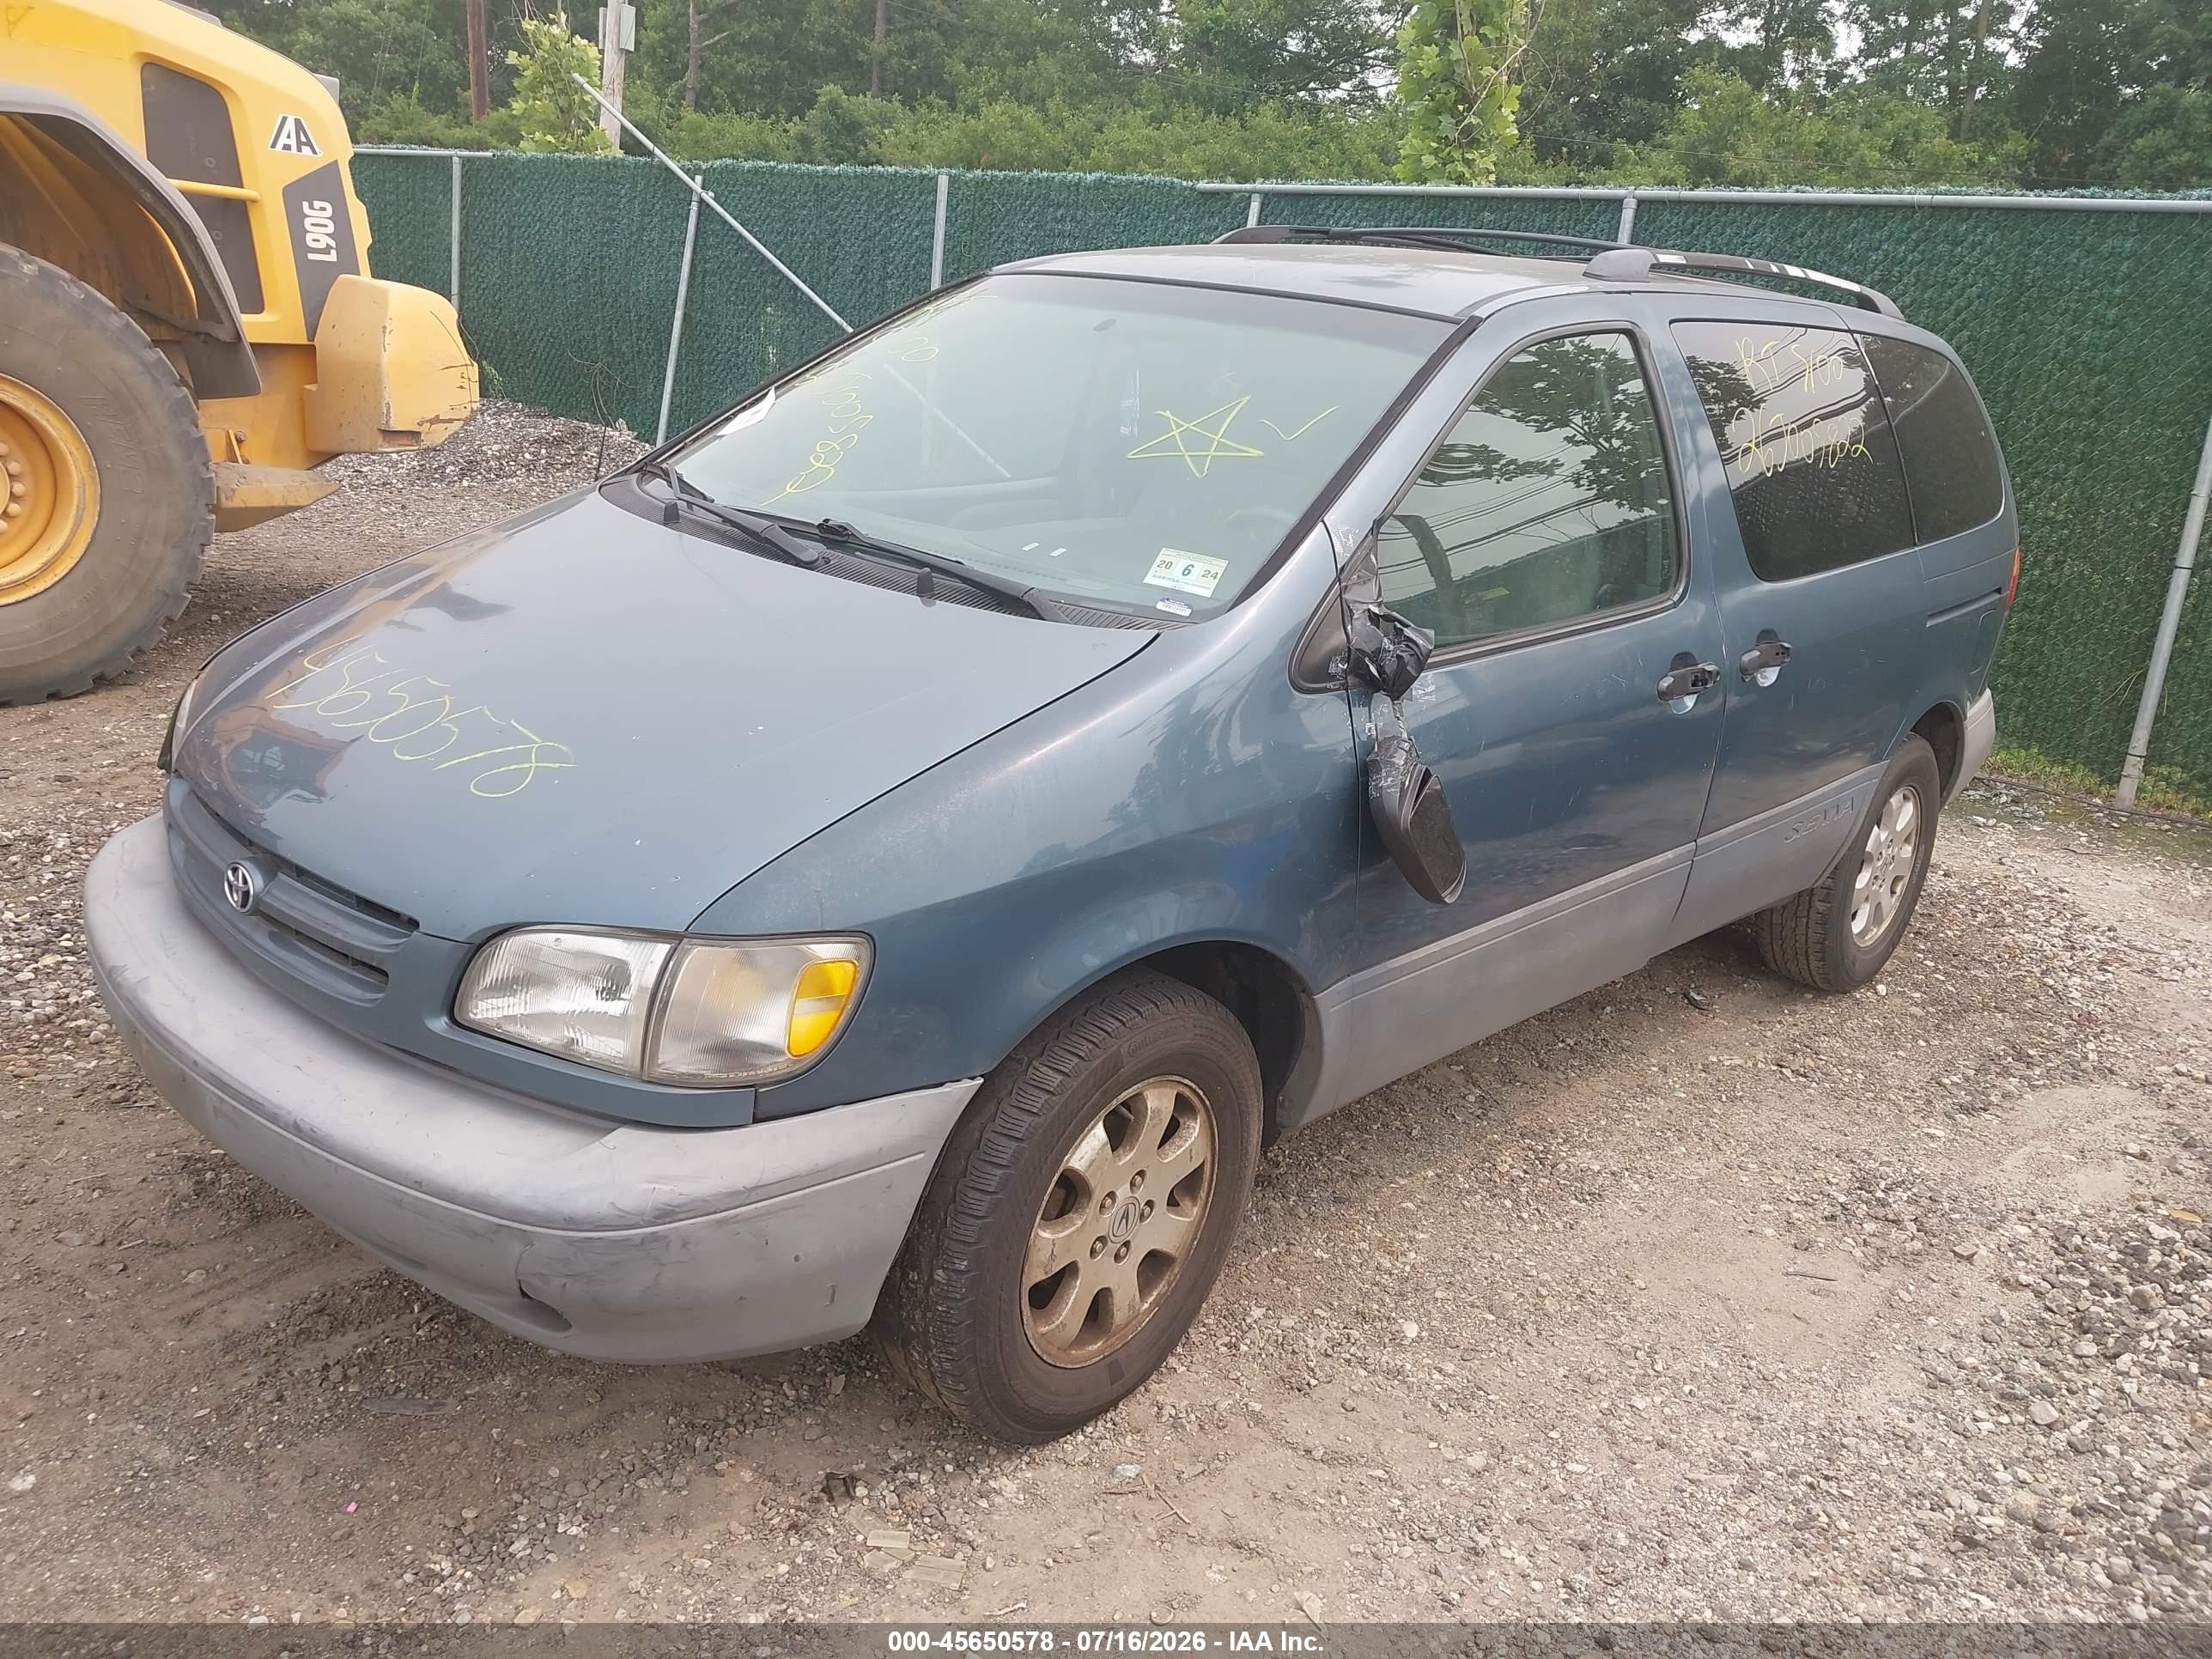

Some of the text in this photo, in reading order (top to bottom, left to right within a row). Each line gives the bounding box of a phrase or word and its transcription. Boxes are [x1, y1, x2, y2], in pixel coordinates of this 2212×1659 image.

[302, 200, 337, 262] L90G
[1157, 560, 1219, 580] 20 6 24
[265, 635, 578, 797] 45650578
